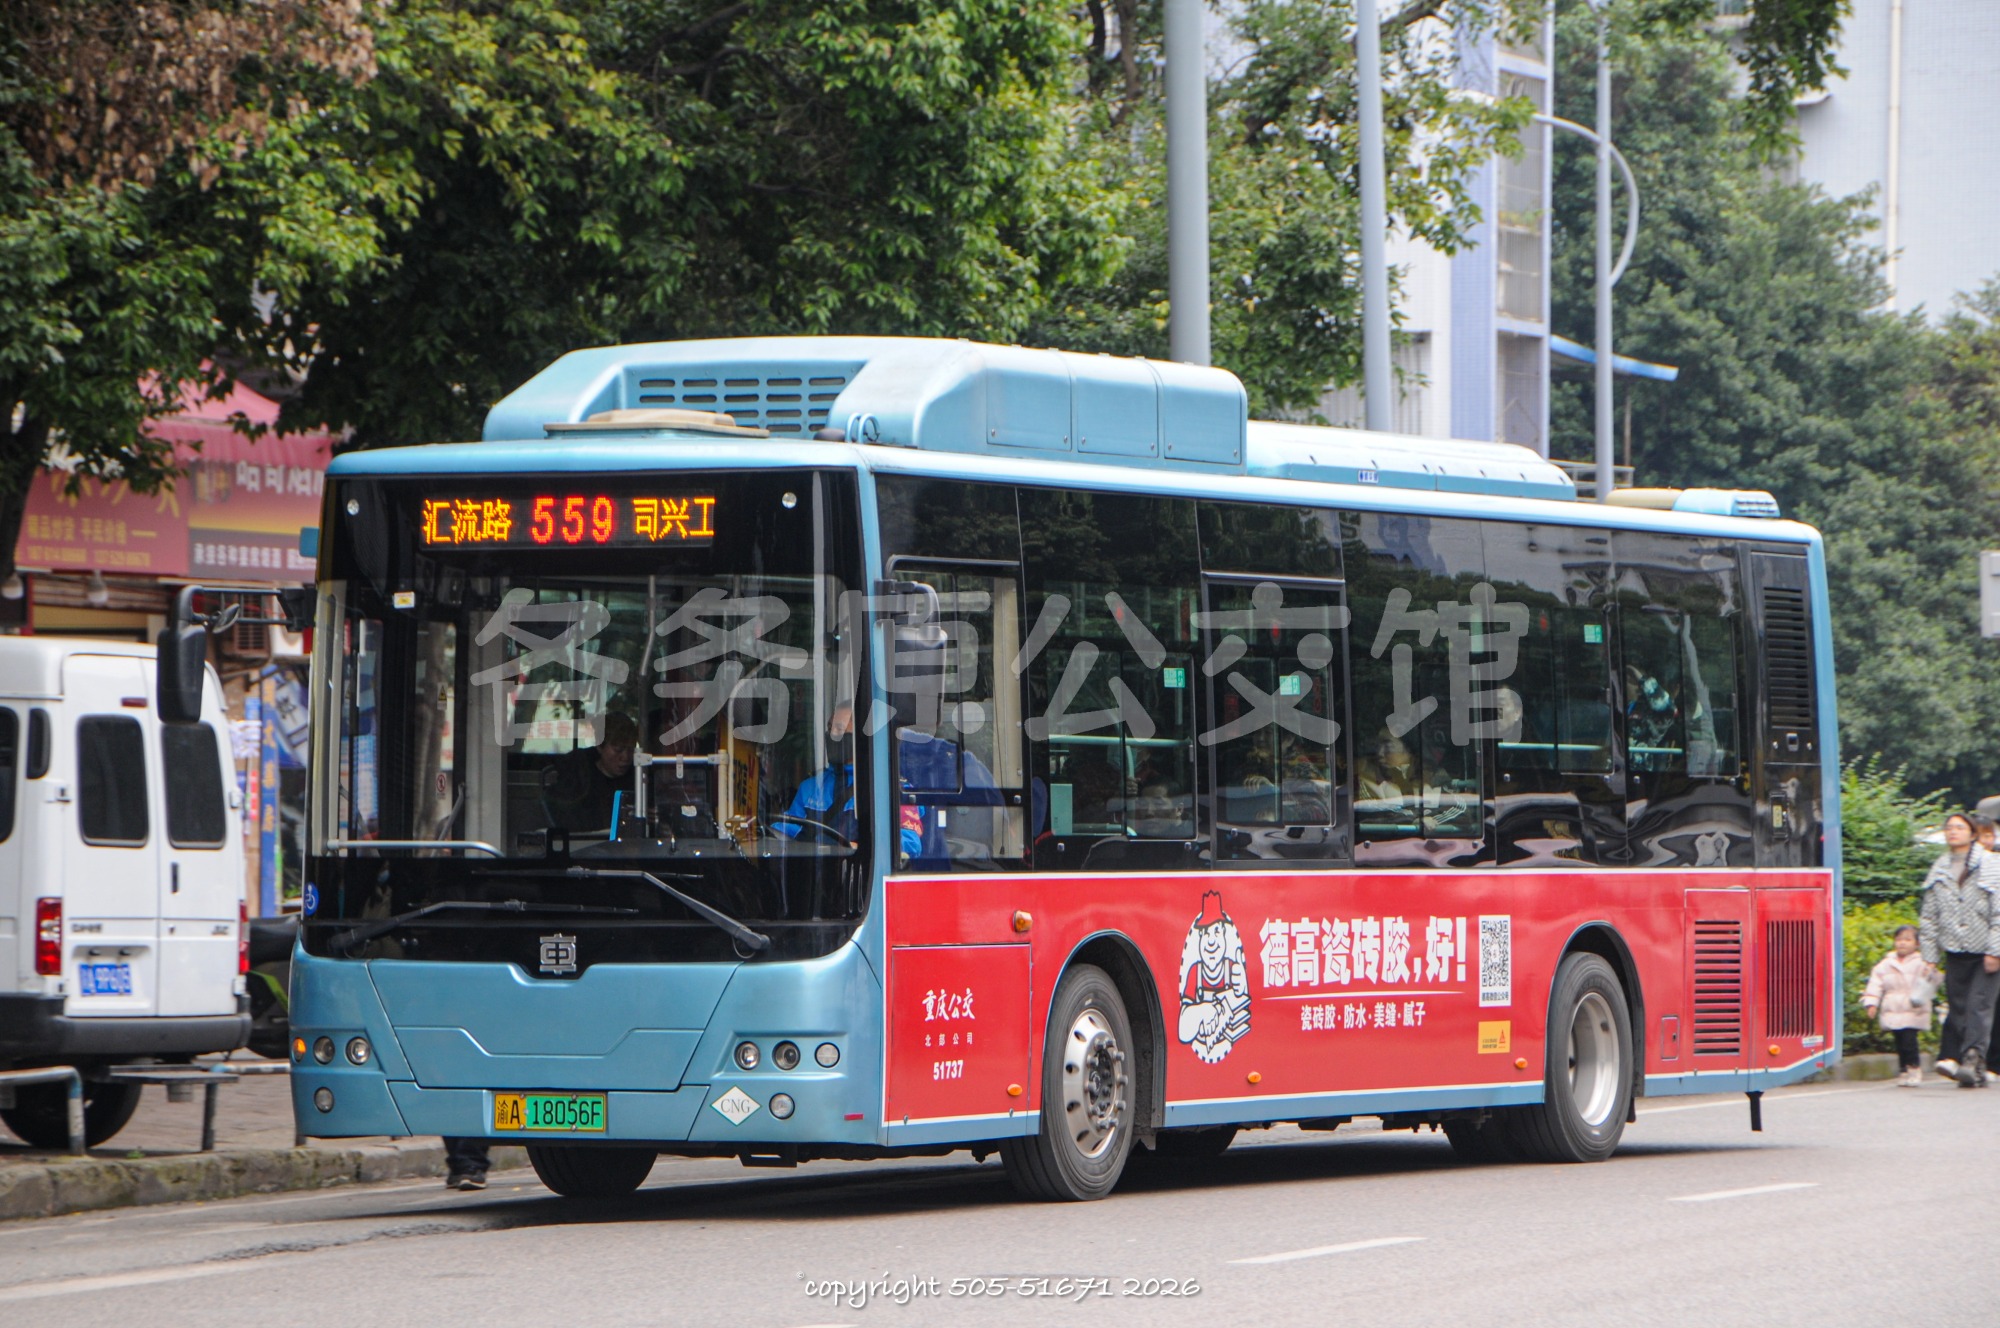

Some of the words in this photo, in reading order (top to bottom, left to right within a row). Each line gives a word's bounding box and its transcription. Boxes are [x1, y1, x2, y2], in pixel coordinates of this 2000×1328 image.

[423, 498, 512, 544] 汇流路
[531, 496, 616, 543] 559
[633, 498, 715, 541] 司兴工
[922, 987, 976, 1021] 重庆公交
[925, 1032, 973, 1047] 北部公司
[933, 1060, 964, 1080] 51737
[720, 1098, 751, 1113] CNG
